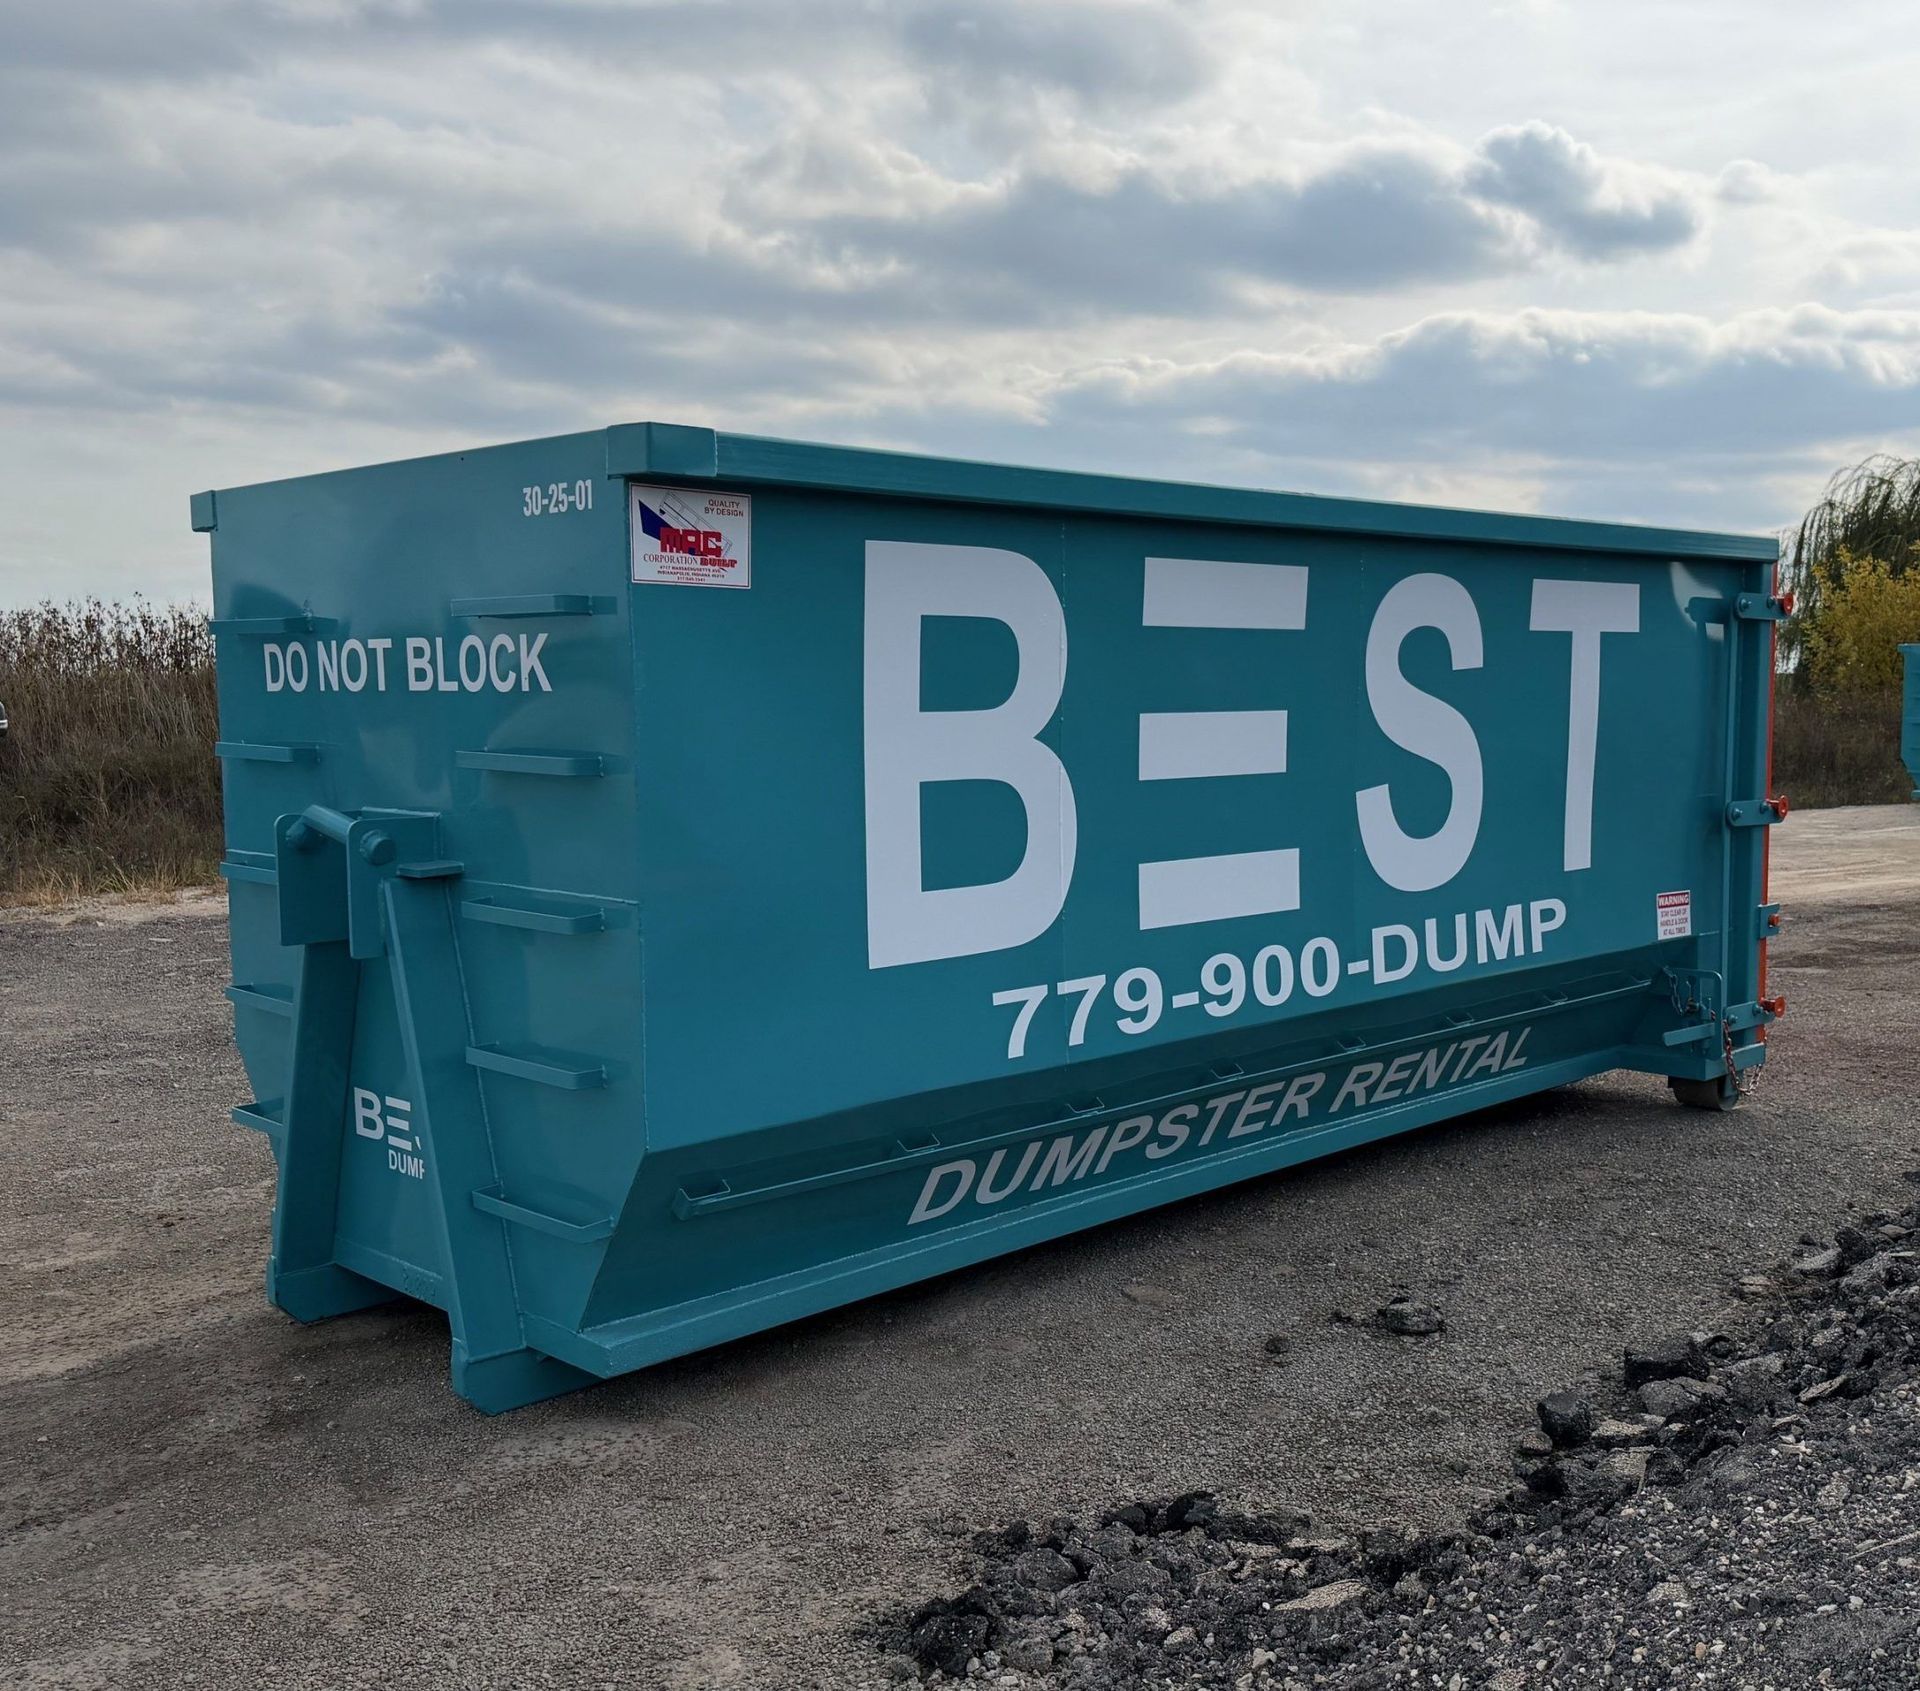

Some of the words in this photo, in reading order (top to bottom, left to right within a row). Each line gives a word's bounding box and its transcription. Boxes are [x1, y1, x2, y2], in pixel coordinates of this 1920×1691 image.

[522, 479, 593, 517] 30-25-01
[704, 507, 715, 515] BY
[716, 508, 744, 517] DESIGN
[708, 499, 740, 509] QUALITY
[643, 553, 698, 566] CORPORATION
[660, 527, 723, 558] MAC
[264, 642, 309, 692] DO
[317, 638, 392, 692] NOT
[406, 633, 552, 693] BLOCK
[864, 540, 1640, 969] BEST
[1658, 894, 1689, 906] WARNING
[992, 898, 1567, 1060] 779-900-DUMP
[354, 1087, 421, 1152] BE
[907, 1074, 1325, 1226] DUMPSTER
[1328, 1027, 1532, 1113] RENTAL
